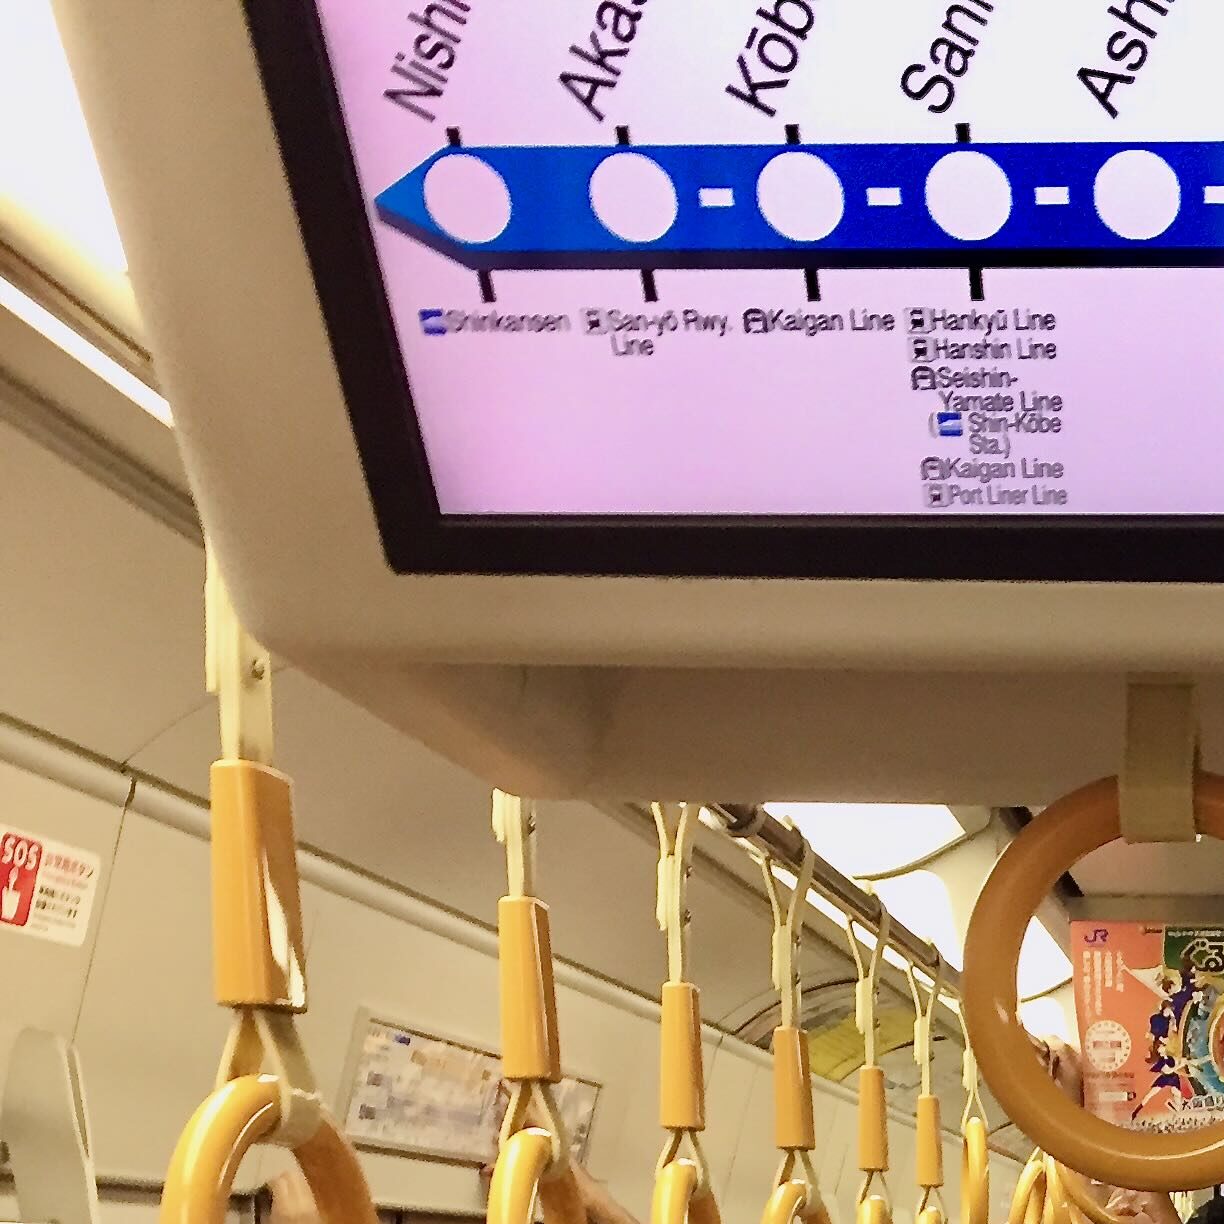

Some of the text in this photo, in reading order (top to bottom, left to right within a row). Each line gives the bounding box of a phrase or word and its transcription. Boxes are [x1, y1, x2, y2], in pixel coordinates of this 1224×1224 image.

[558, 0, 648, 121] Aka
[1077, 0, 1176, 119] Ash
[446, 309, 571, 333] Shinkansen
[682, 308, 732, 336] Rwy.
[768, 308, 895, 336] Kaigan Line
[933, 308, 1057, 335] Hankyū Line
[611, 333, 654, 356] Line
[936, 337, 1057, 359] Hanshin Line
[937, 366, 1019, 388] Seishin-
[938, 390, 1063, 411] Yamate Line
[947, 457, 1065, 483] Kaigan Line
[950, 484, 1068, 505] Port Liner Line
[1, 835, 39, 871] SOS
[1084, 928, 1109, 943] JR
